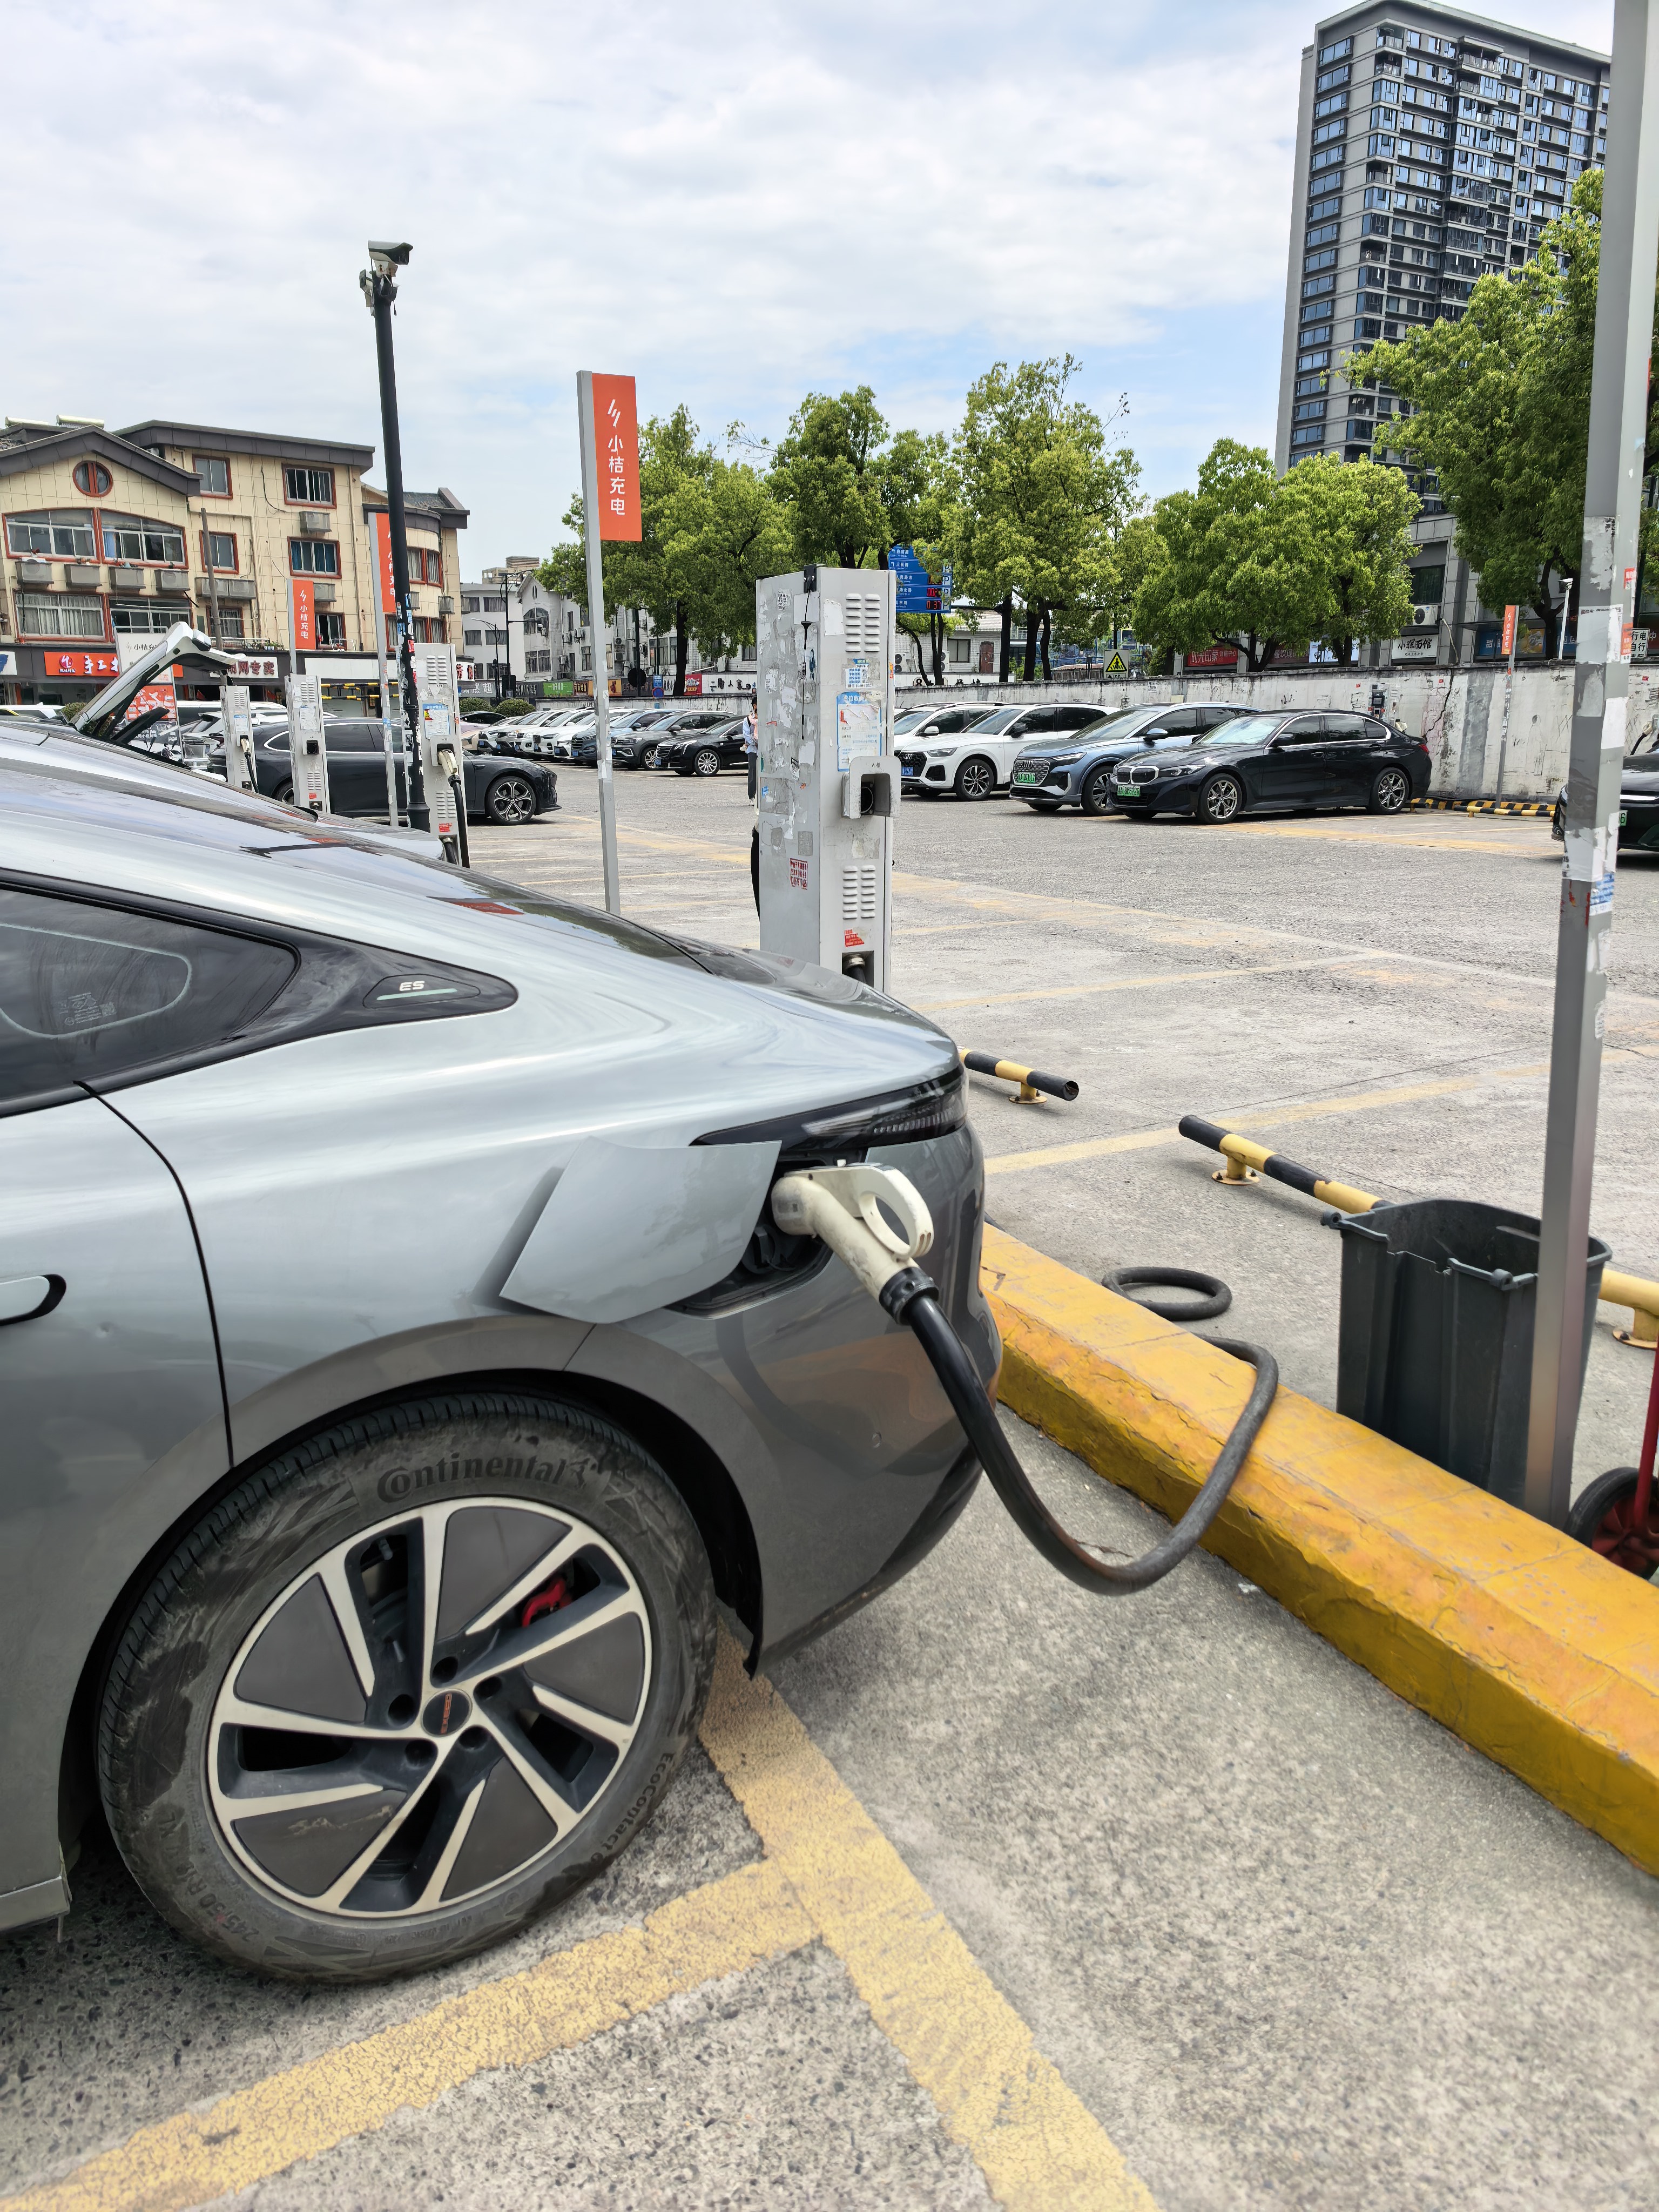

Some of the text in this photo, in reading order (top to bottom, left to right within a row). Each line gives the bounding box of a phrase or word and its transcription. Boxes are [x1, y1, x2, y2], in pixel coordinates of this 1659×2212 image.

[608, 434, 625, 515] 小桔充电
[944, 576, 949, 584] P
[300, 605, 309, 639] 小桔充电
[399, 980, 425, 992] ES
[377, 1452, 565, 1503] Continental
[601, 1752, 676, 1850] EcoContact
